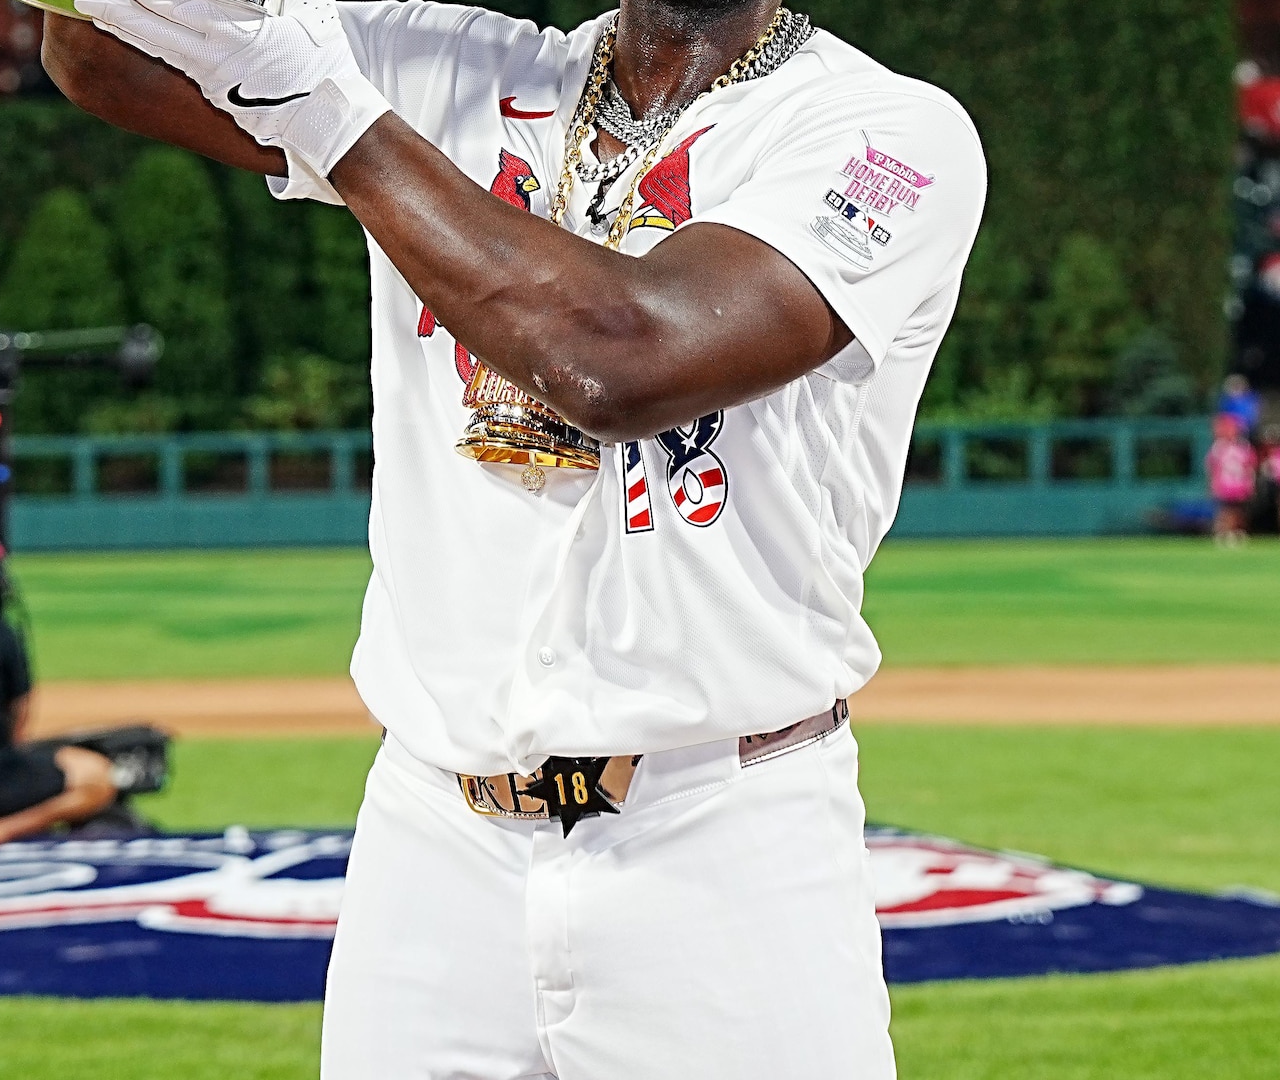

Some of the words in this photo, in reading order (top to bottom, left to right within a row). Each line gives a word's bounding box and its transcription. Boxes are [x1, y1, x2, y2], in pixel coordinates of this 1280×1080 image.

[842, 156, 889, 193] HOME
[887, 180, 922, 208] RUN
[884, 157, 918, 183] Mobile
[827, 192, 844, 209] 20
[843, 179, 899, 215] DERBY
[873, 227, 889, 242] 26
[622, 409, 729, 535] 18
[554, 771, 588, 806] 18
